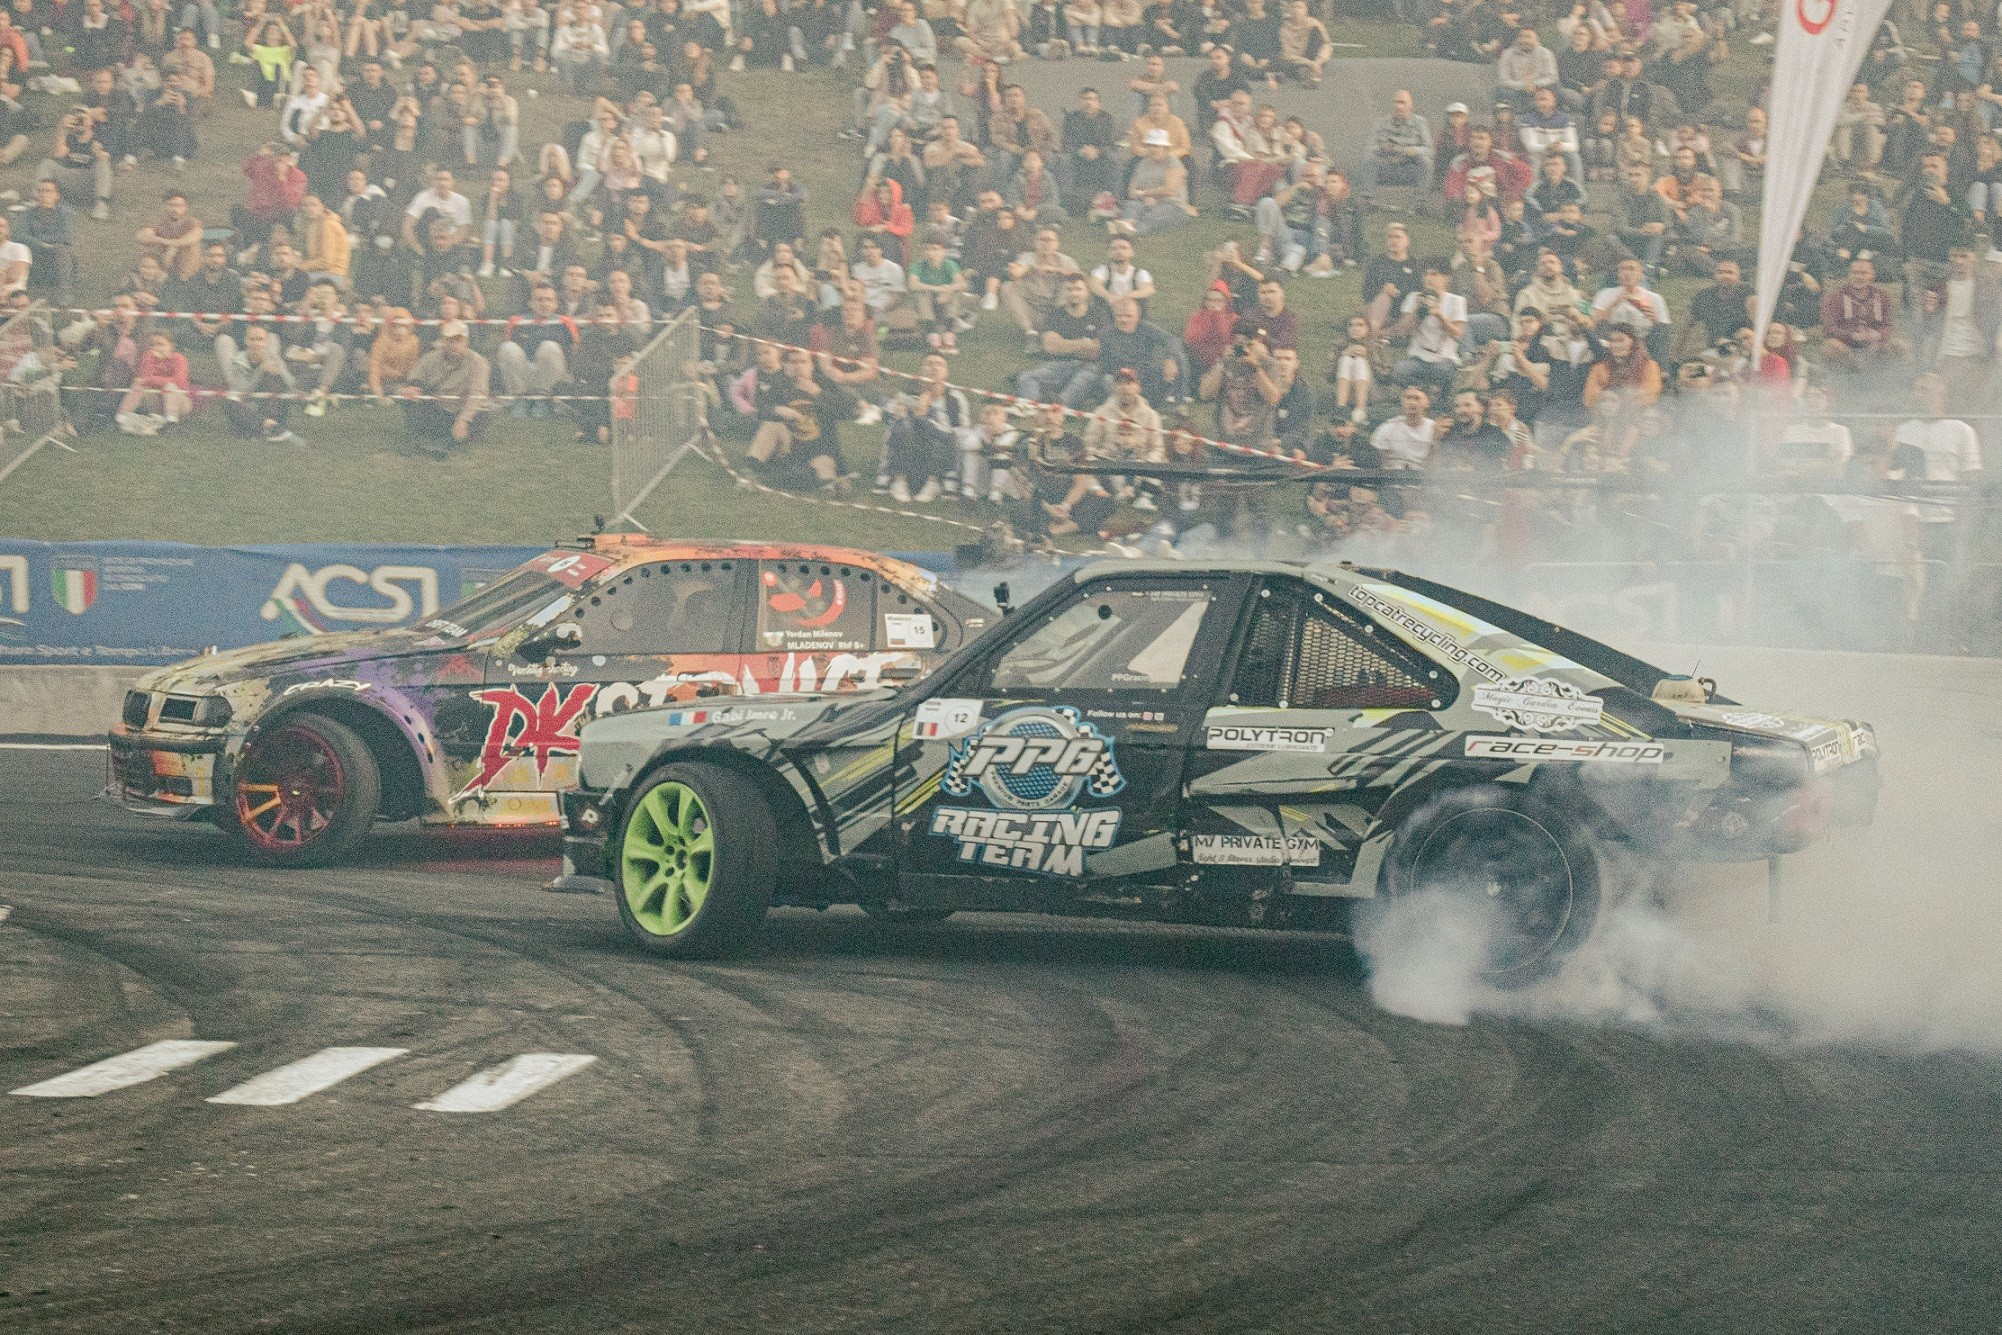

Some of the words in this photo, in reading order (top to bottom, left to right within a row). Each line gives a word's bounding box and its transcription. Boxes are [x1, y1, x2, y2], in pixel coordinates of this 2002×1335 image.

[260, 562, 440, 622] ACSI
[913, 625, 926, 635] 15
[1349, 585, 1506, 682] topcatrecycling.com
[787, 641, 834, 649] MLADENOV
[282, 677, 373, 696] CRAZY
[780, 708, 796, 721] Jr.
[953, 712, 968, 724] 12
[1086, 709, 1114, 718] Follow
[1208, 727, 1326, 745] POLYTRON
[962, 736, 1105, 777] PPG
[1466, 738, 1664, 763] race-shop
[1016, 799, 1041, 807] PARTS
[932, 808, 1121, 847] RACING
[1221, 837, 1281, 850] PRIVATE
[1287, 838, 1319, 851] GYM
[958, 836, 1083, 877] TEAM
